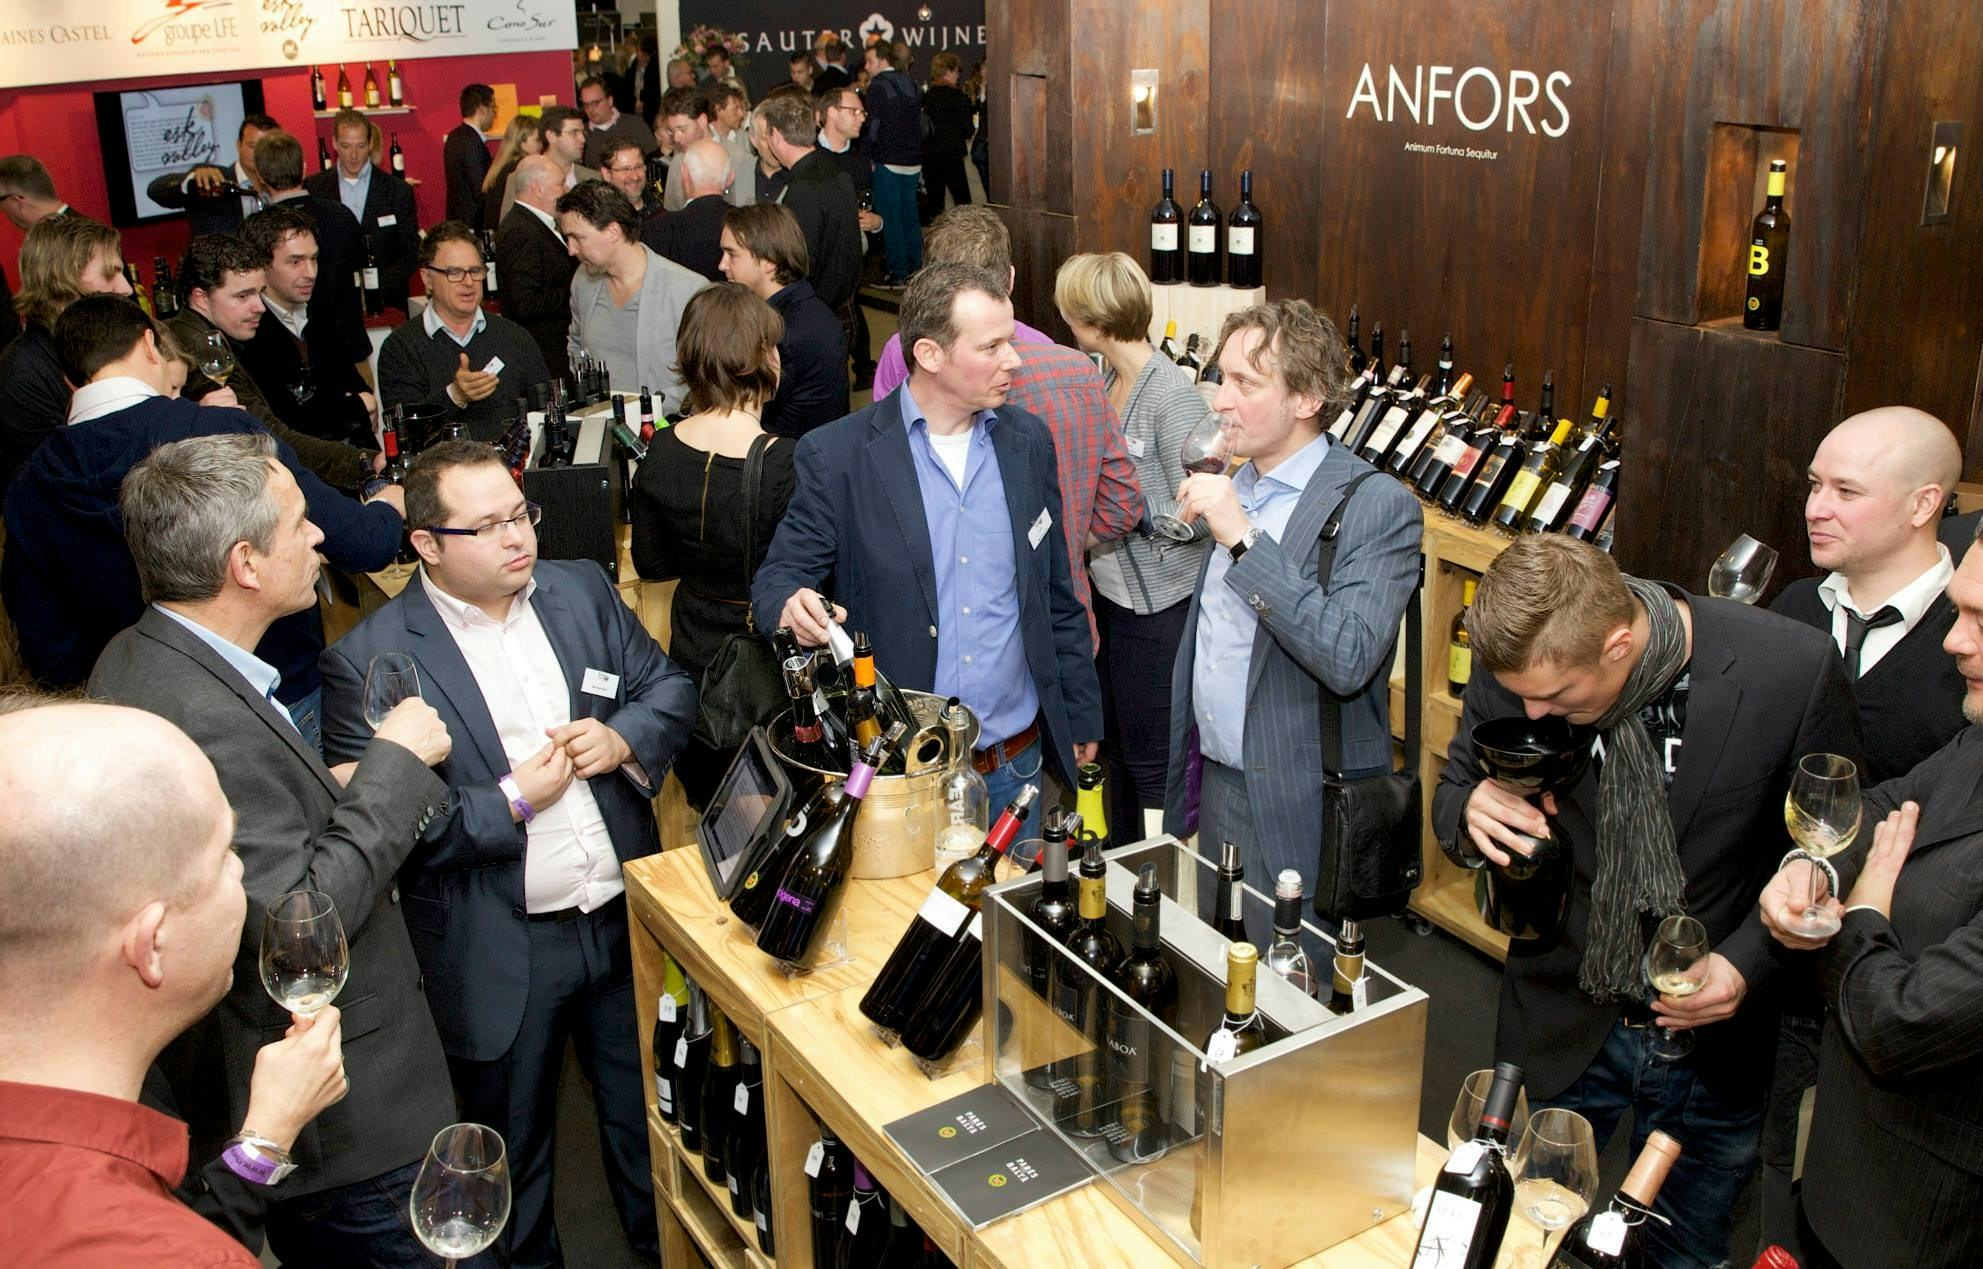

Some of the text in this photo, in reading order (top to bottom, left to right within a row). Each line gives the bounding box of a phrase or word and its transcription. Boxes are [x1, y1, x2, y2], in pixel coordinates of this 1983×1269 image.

[164, 17, 240, 46] groupe LFE
[341, 5, 465, 41] TARIQUET
[737, 28, 854, 53] SAUTR
[1346, 62, 1572, 138] ANFORS
[1404, 142, 1498, 160] Animum Fortuna Sequitur
[1748, 244, 1769, 276] B
